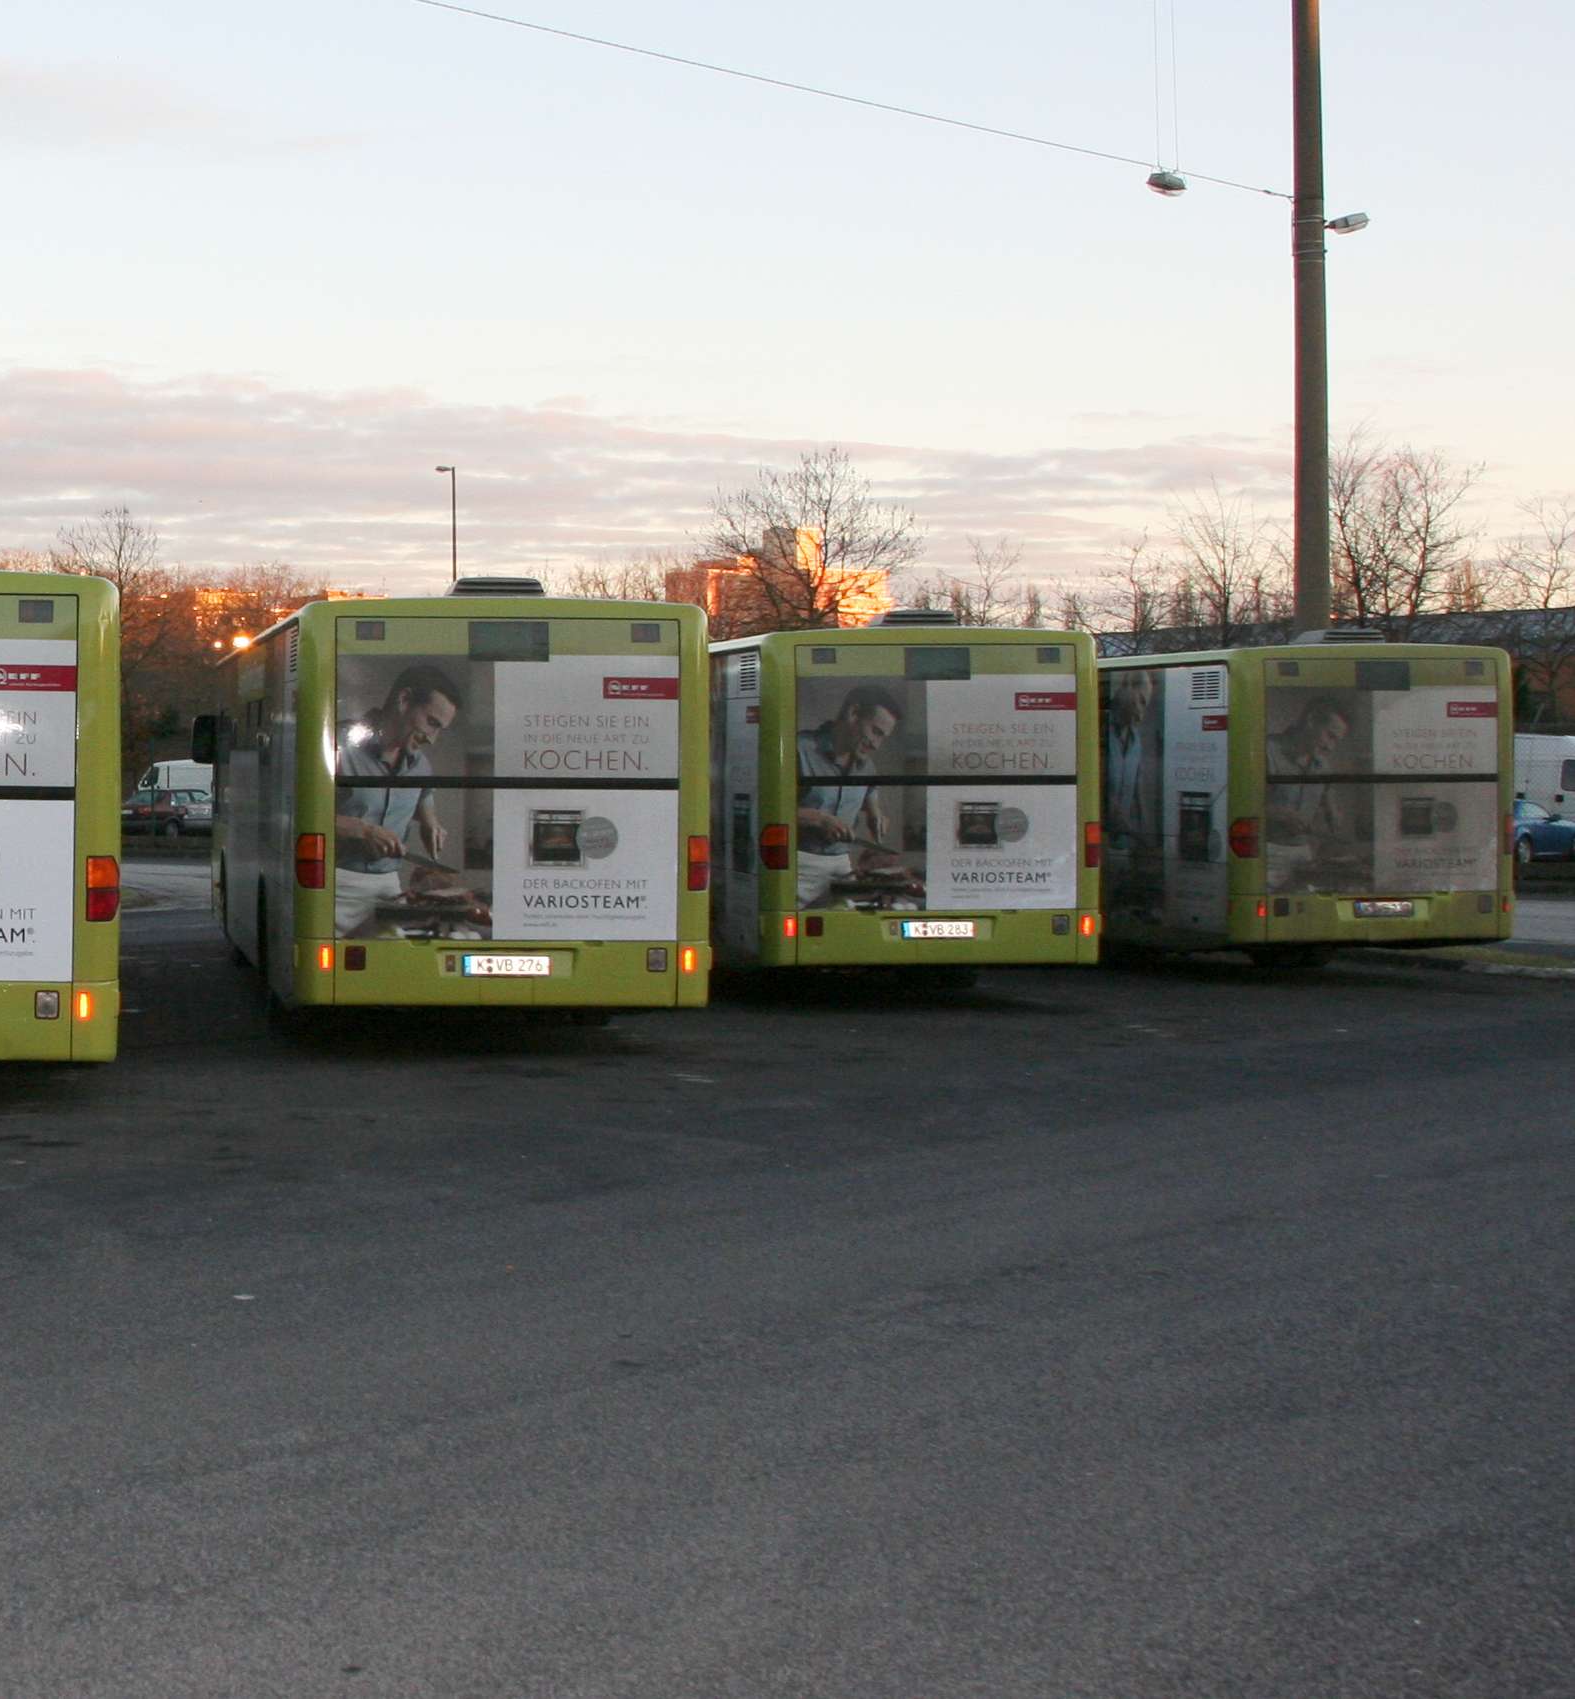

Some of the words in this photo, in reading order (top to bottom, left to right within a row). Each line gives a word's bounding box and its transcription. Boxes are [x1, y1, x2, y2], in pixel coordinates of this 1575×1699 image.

[523, 714, 590, 728] STEIGEN
[596, 714, 617, 728] SIE
[624, 715, 650, 728] EIN
[952, 722, 1005, 735] STEIGEN
[1033, 722, 1055, 734] EIN
[15, 732, 37, 744] ZU
[523, 734, 537, 744] IN
[542, 734, 562, 744] DIE
[566, 734, 599, 744] NEUE
[603, 734, 626, 744] ART
[632, 734, 649, 745] ZU
[523, 749, 649, 771] KOCHEN.
[523, 878, 548, 890] DER
[553, 878, 621, 890] BACKOFEN
[626, 879, 648, 890] MIT
[10, 908, 36, 920] MIT
[947, 924, 969, 935] 283
[477, 959, 486, 971] K
[496, 959, 514, 972] VB
[518, 959, 543, 972] 276
